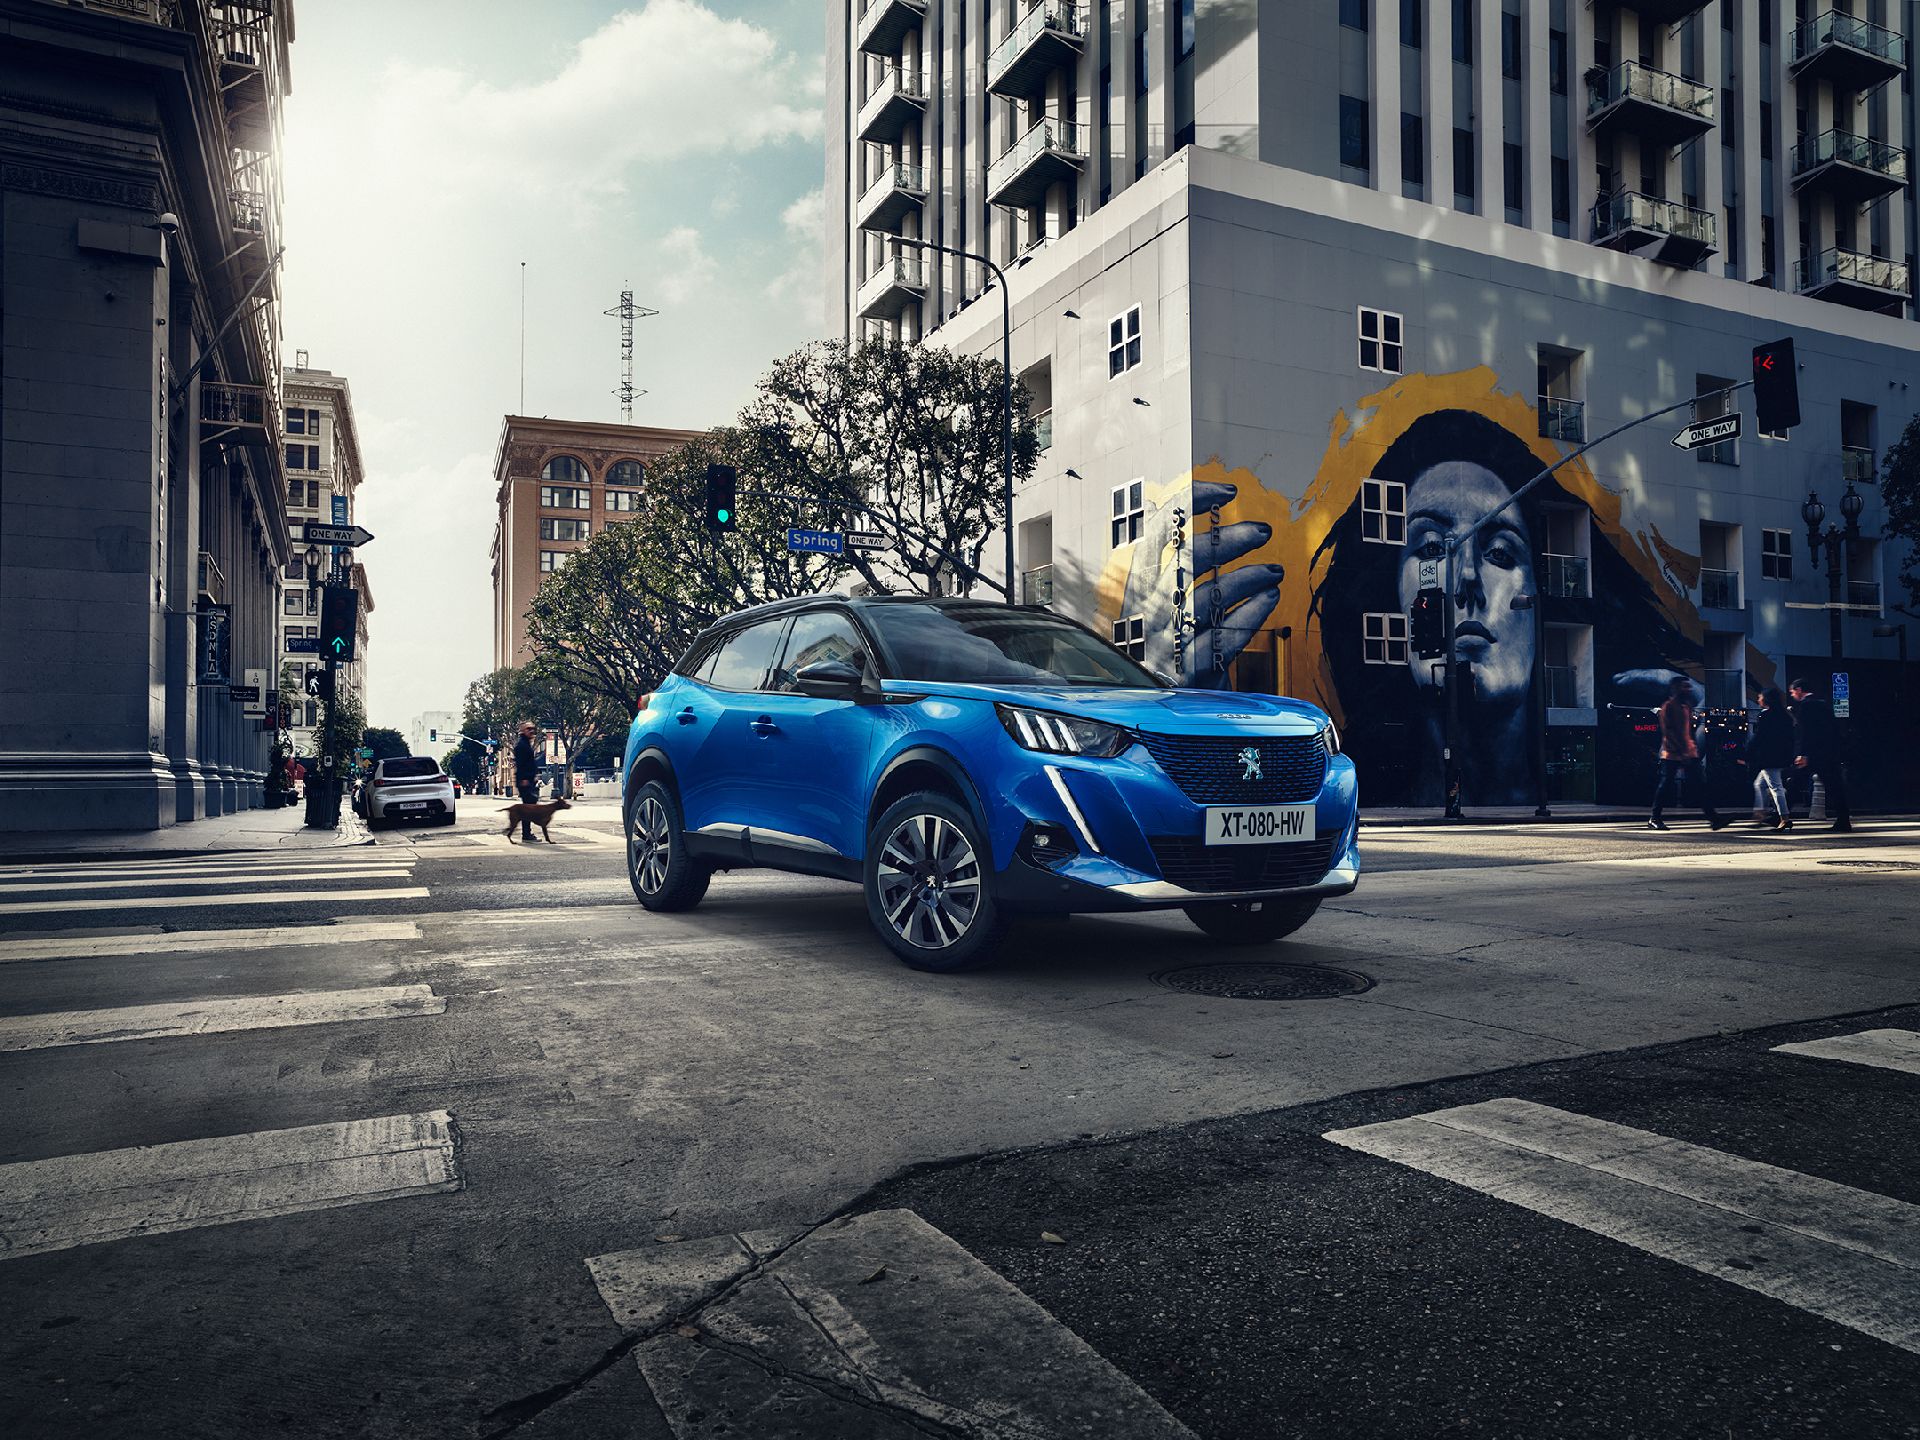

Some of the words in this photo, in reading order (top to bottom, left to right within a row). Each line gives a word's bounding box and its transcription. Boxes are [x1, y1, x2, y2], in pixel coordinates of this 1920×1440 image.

[1690, 428, 1711, 441] ONE
[1713, 421, 1734, 436] WAY
[310, 529, 331, 539] ONE
[333, 531, 353, 541] WAY
[1172, 506, 1183, 550] SB
[793, 533, 838, 549] Spring
[850, 536, 866, 545] ONE
[868, 538, 884, 546] WAY
[1171, 566, 1184, 673] TOWER
[1209, 564, 1226, 673] TOWER
[290, 639, 313, 649] Spring
[1634, 724, 1657, 732] MARKE
[1220, 811, 1305, 838] XT-080-HW
